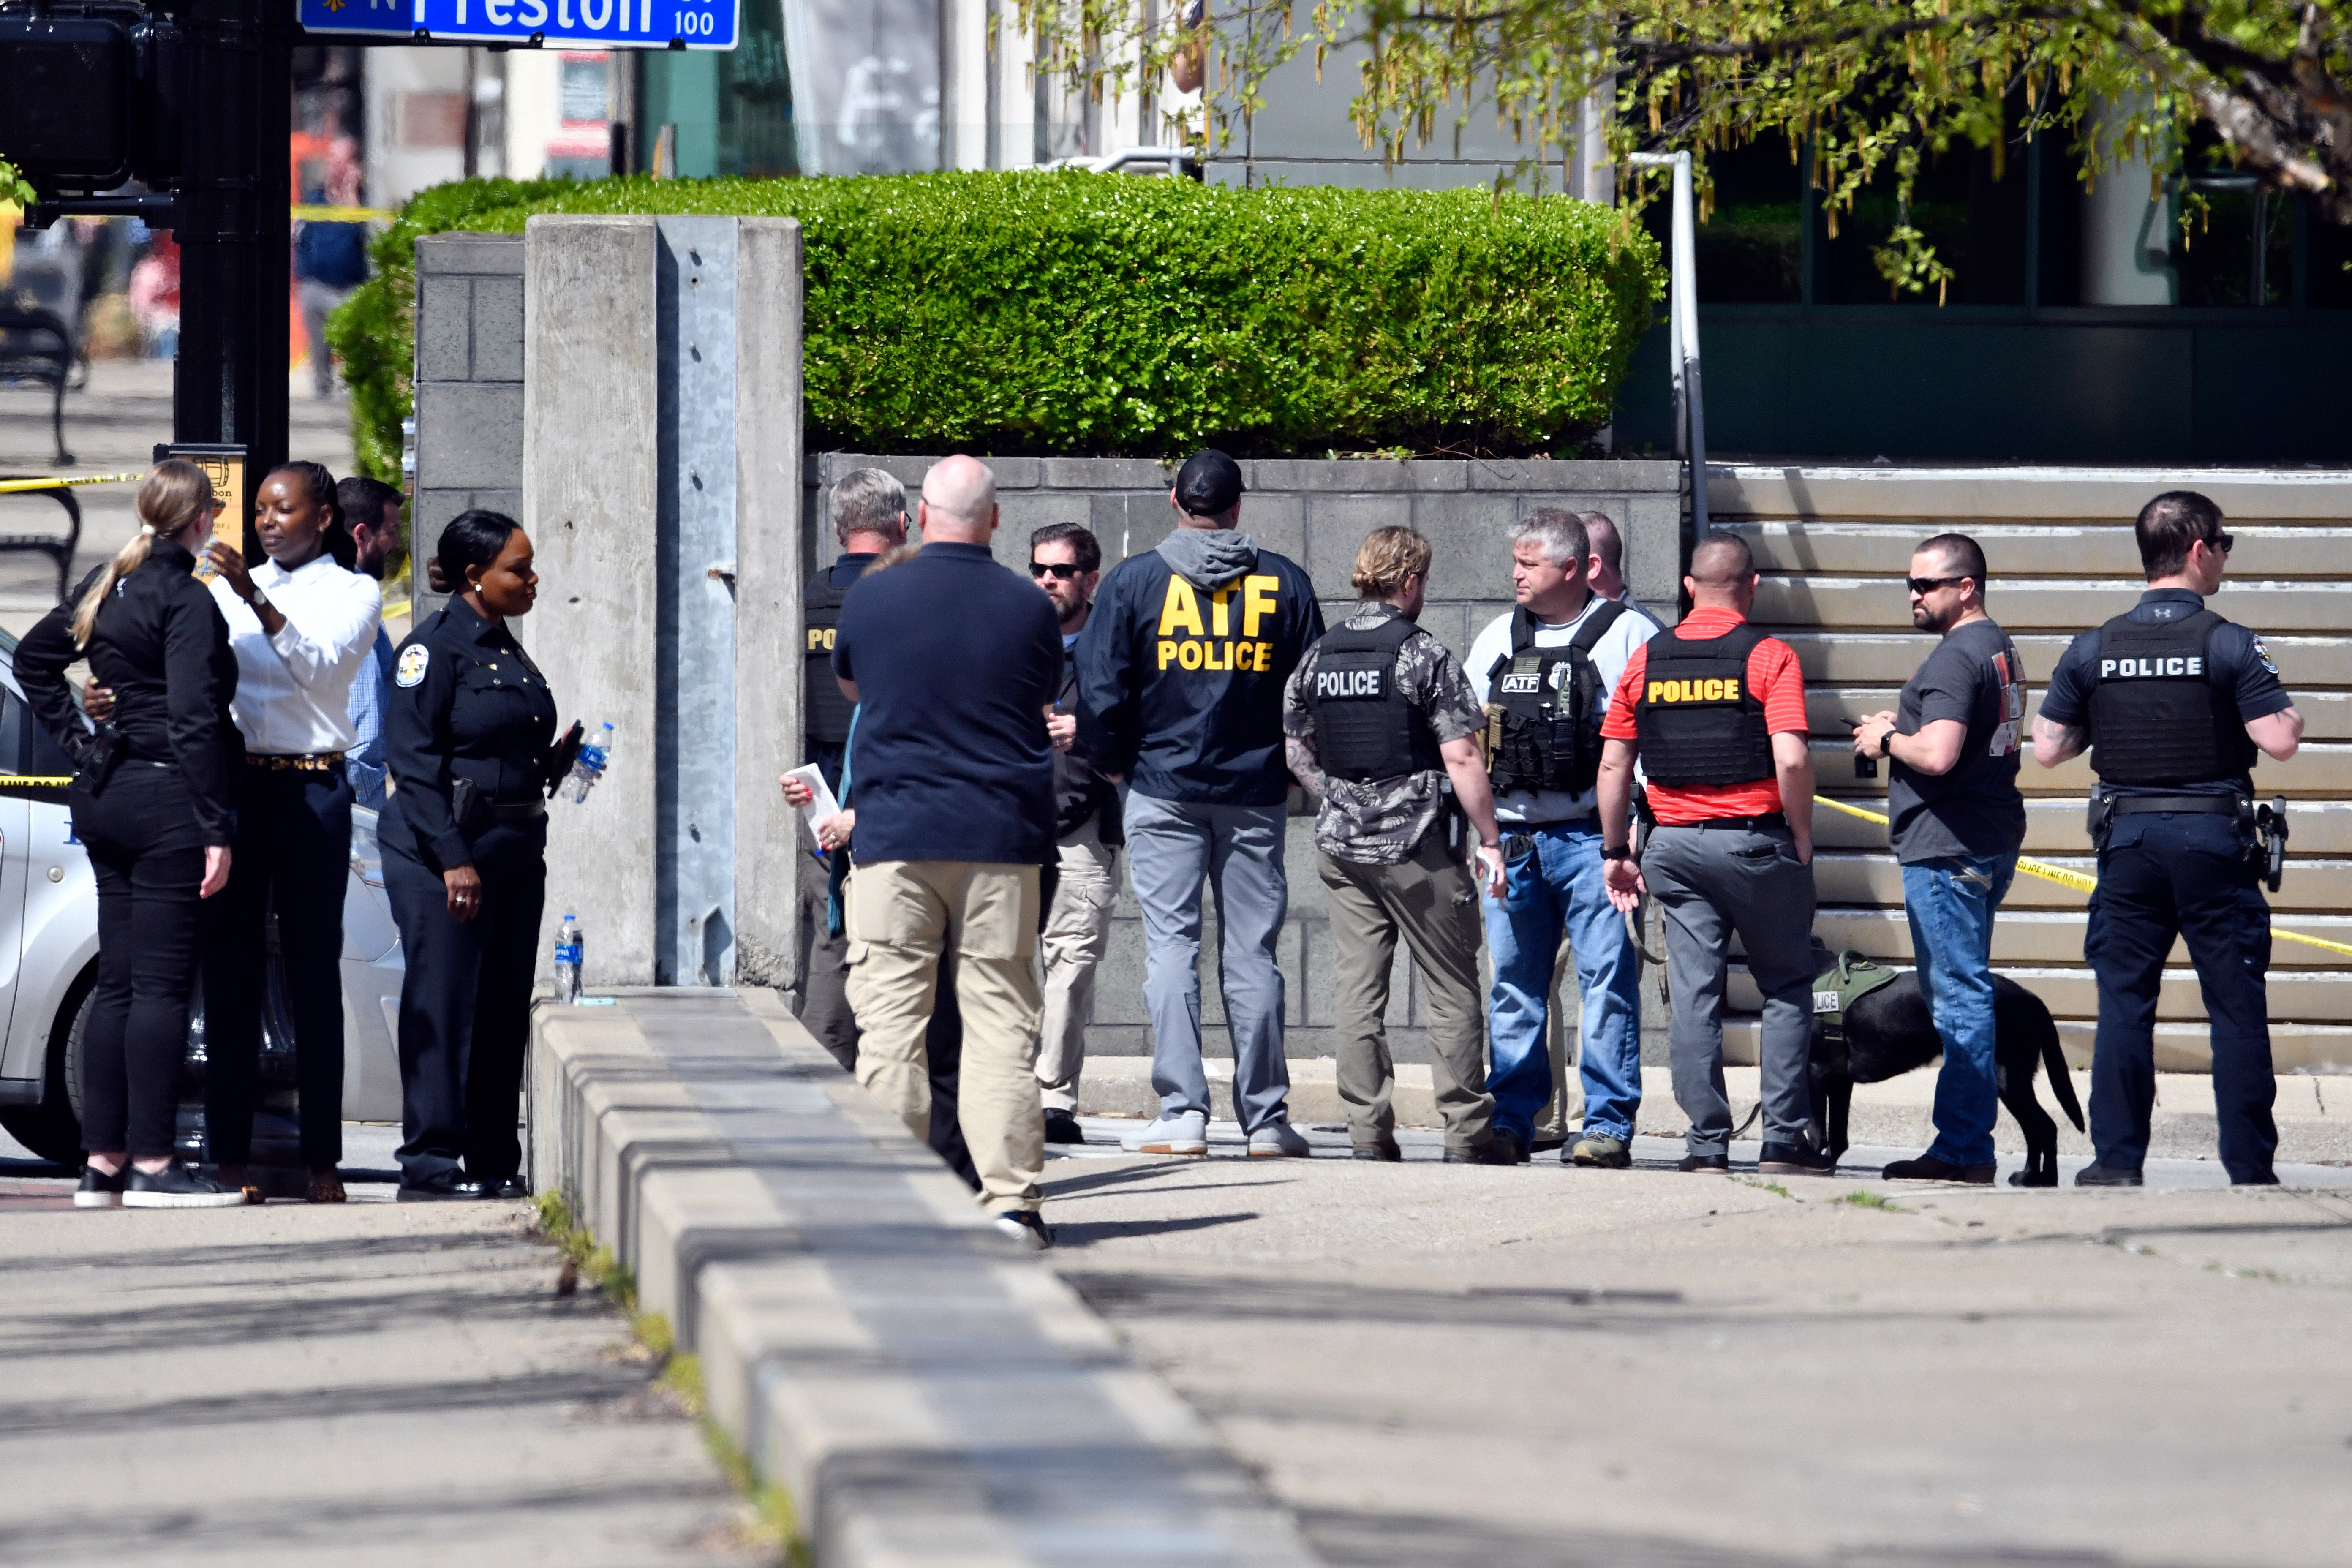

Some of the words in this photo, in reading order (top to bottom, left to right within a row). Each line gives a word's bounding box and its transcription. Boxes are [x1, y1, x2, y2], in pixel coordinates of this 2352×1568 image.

[675, 11, 714, 35] 100
[1158, 574, 1279, 637] ATF
[1157, 640, 1274, 671] POLICE
[2101, 657, 2202, 677] POLICE
[1318, 670, 1380, 696] POLICE
[1505, 677, 1538, 689] ATF
[1648, 679, 1739, 703] POLICE
[2017, 860, 2041, 873] OLICE
[1813, 993, 1836, 1010] LICE
